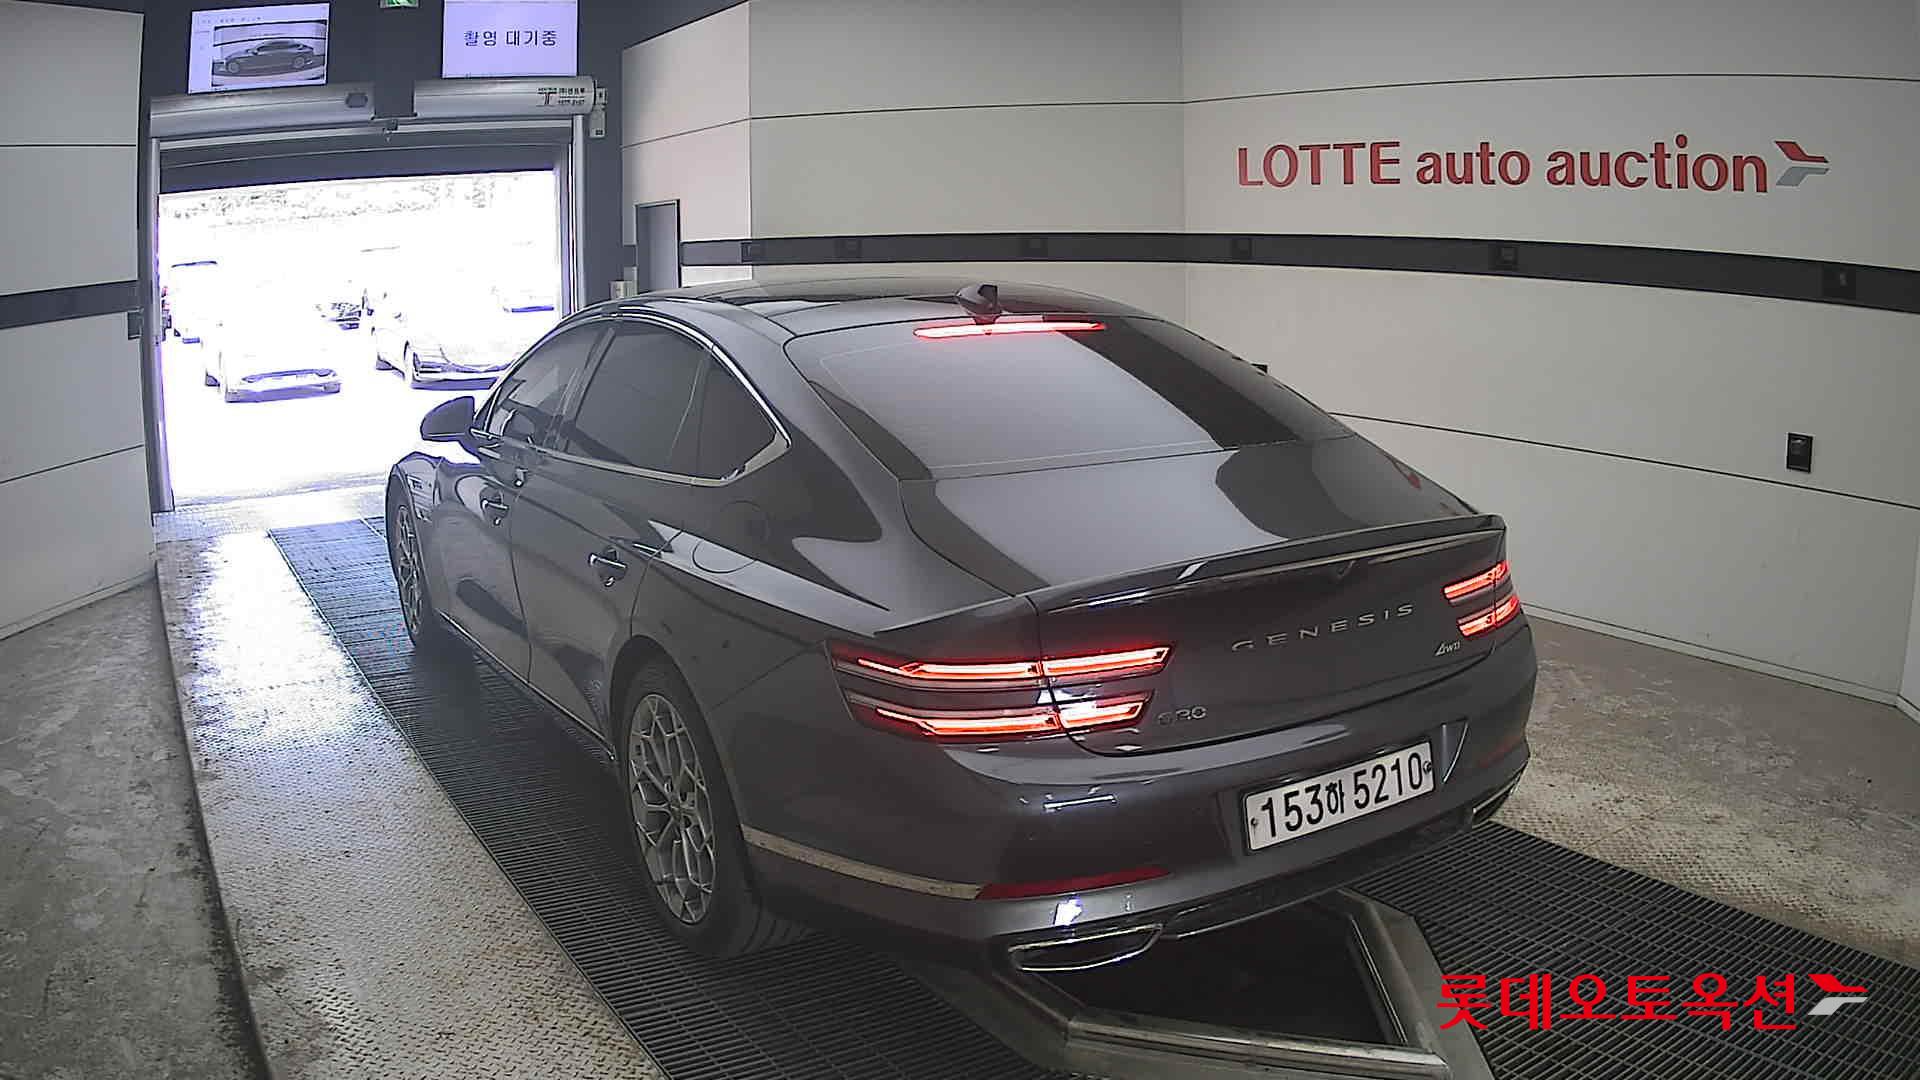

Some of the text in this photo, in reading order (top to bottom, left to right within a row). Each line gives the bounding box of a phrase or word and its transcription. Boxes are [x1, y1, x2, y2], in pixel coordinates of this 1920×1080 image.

[464, 30, 557, 47] 촬영 대기중
[1237, 134, 1768, 193] LOTTE auto auction
[1231, 603, 1413, 652] GENESIS
[1261, 752, 1424, 838] 153하 5210
